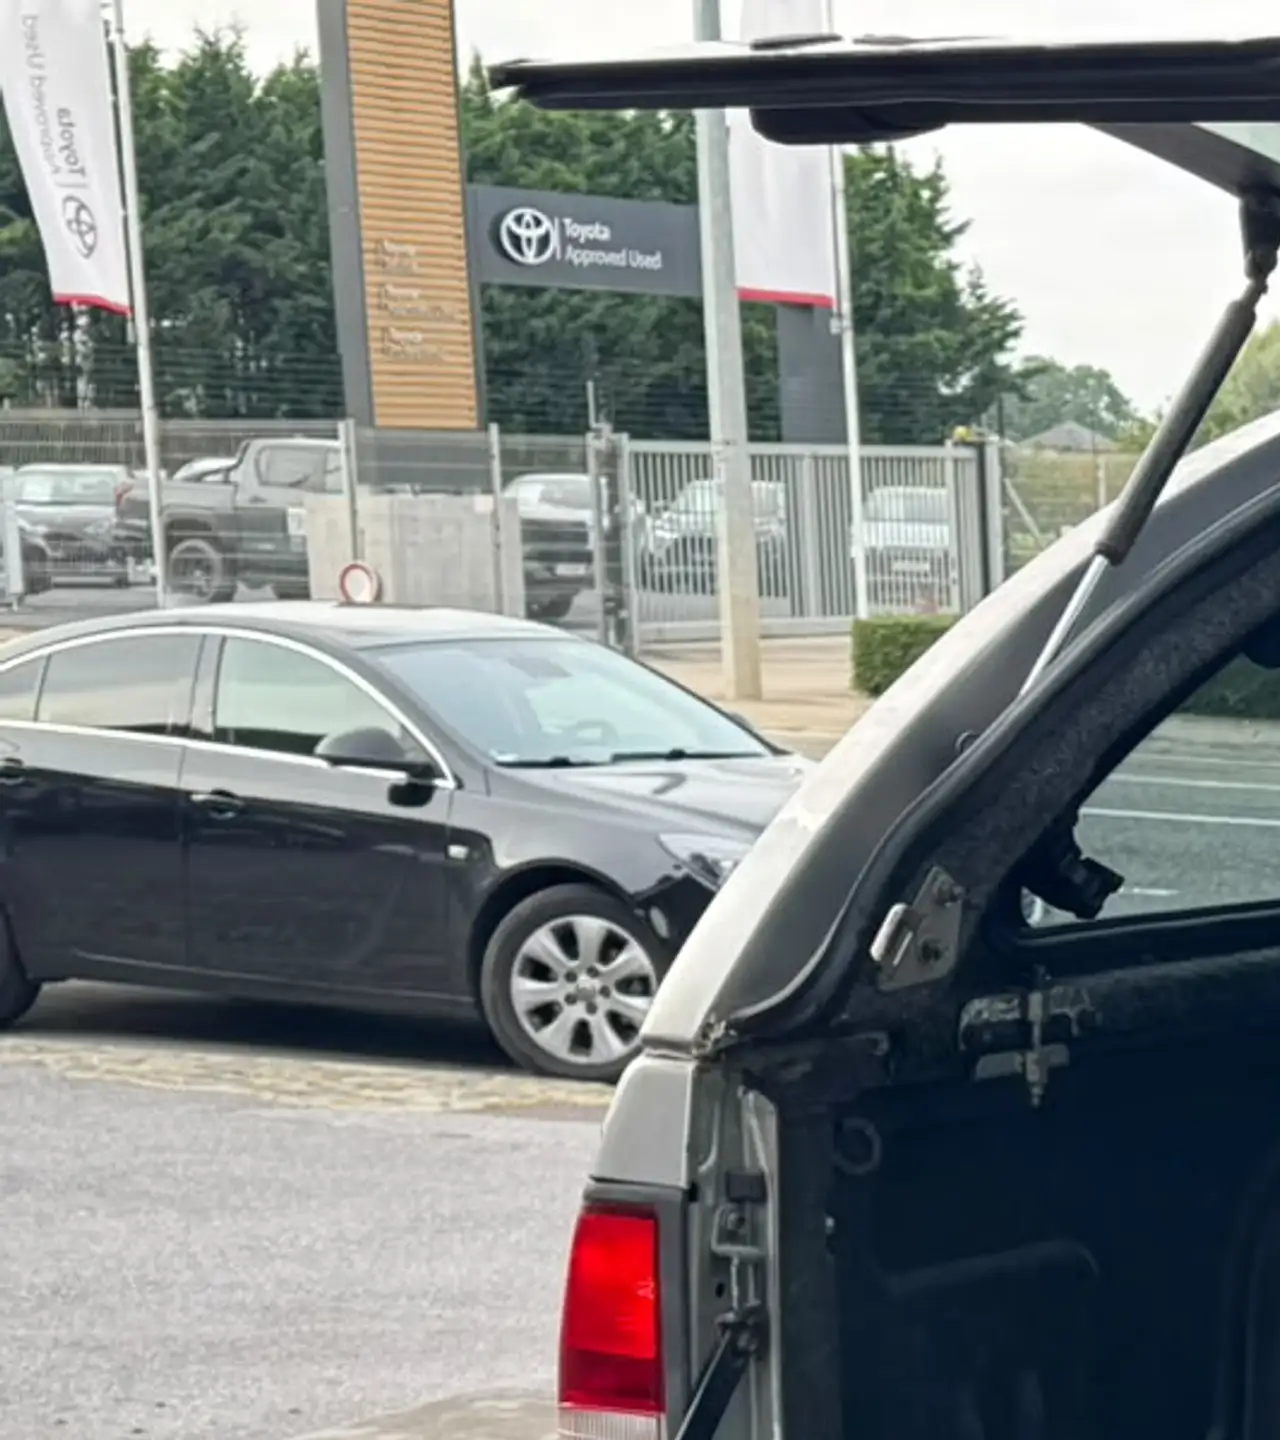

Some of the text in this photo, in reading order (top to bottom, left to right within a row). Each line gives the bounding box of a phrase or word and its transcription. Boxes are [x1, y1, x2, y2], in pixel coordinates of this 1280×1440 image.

[562, 217, 611, 244] Toyota
[565, 244, 662, 270] Approved Used
